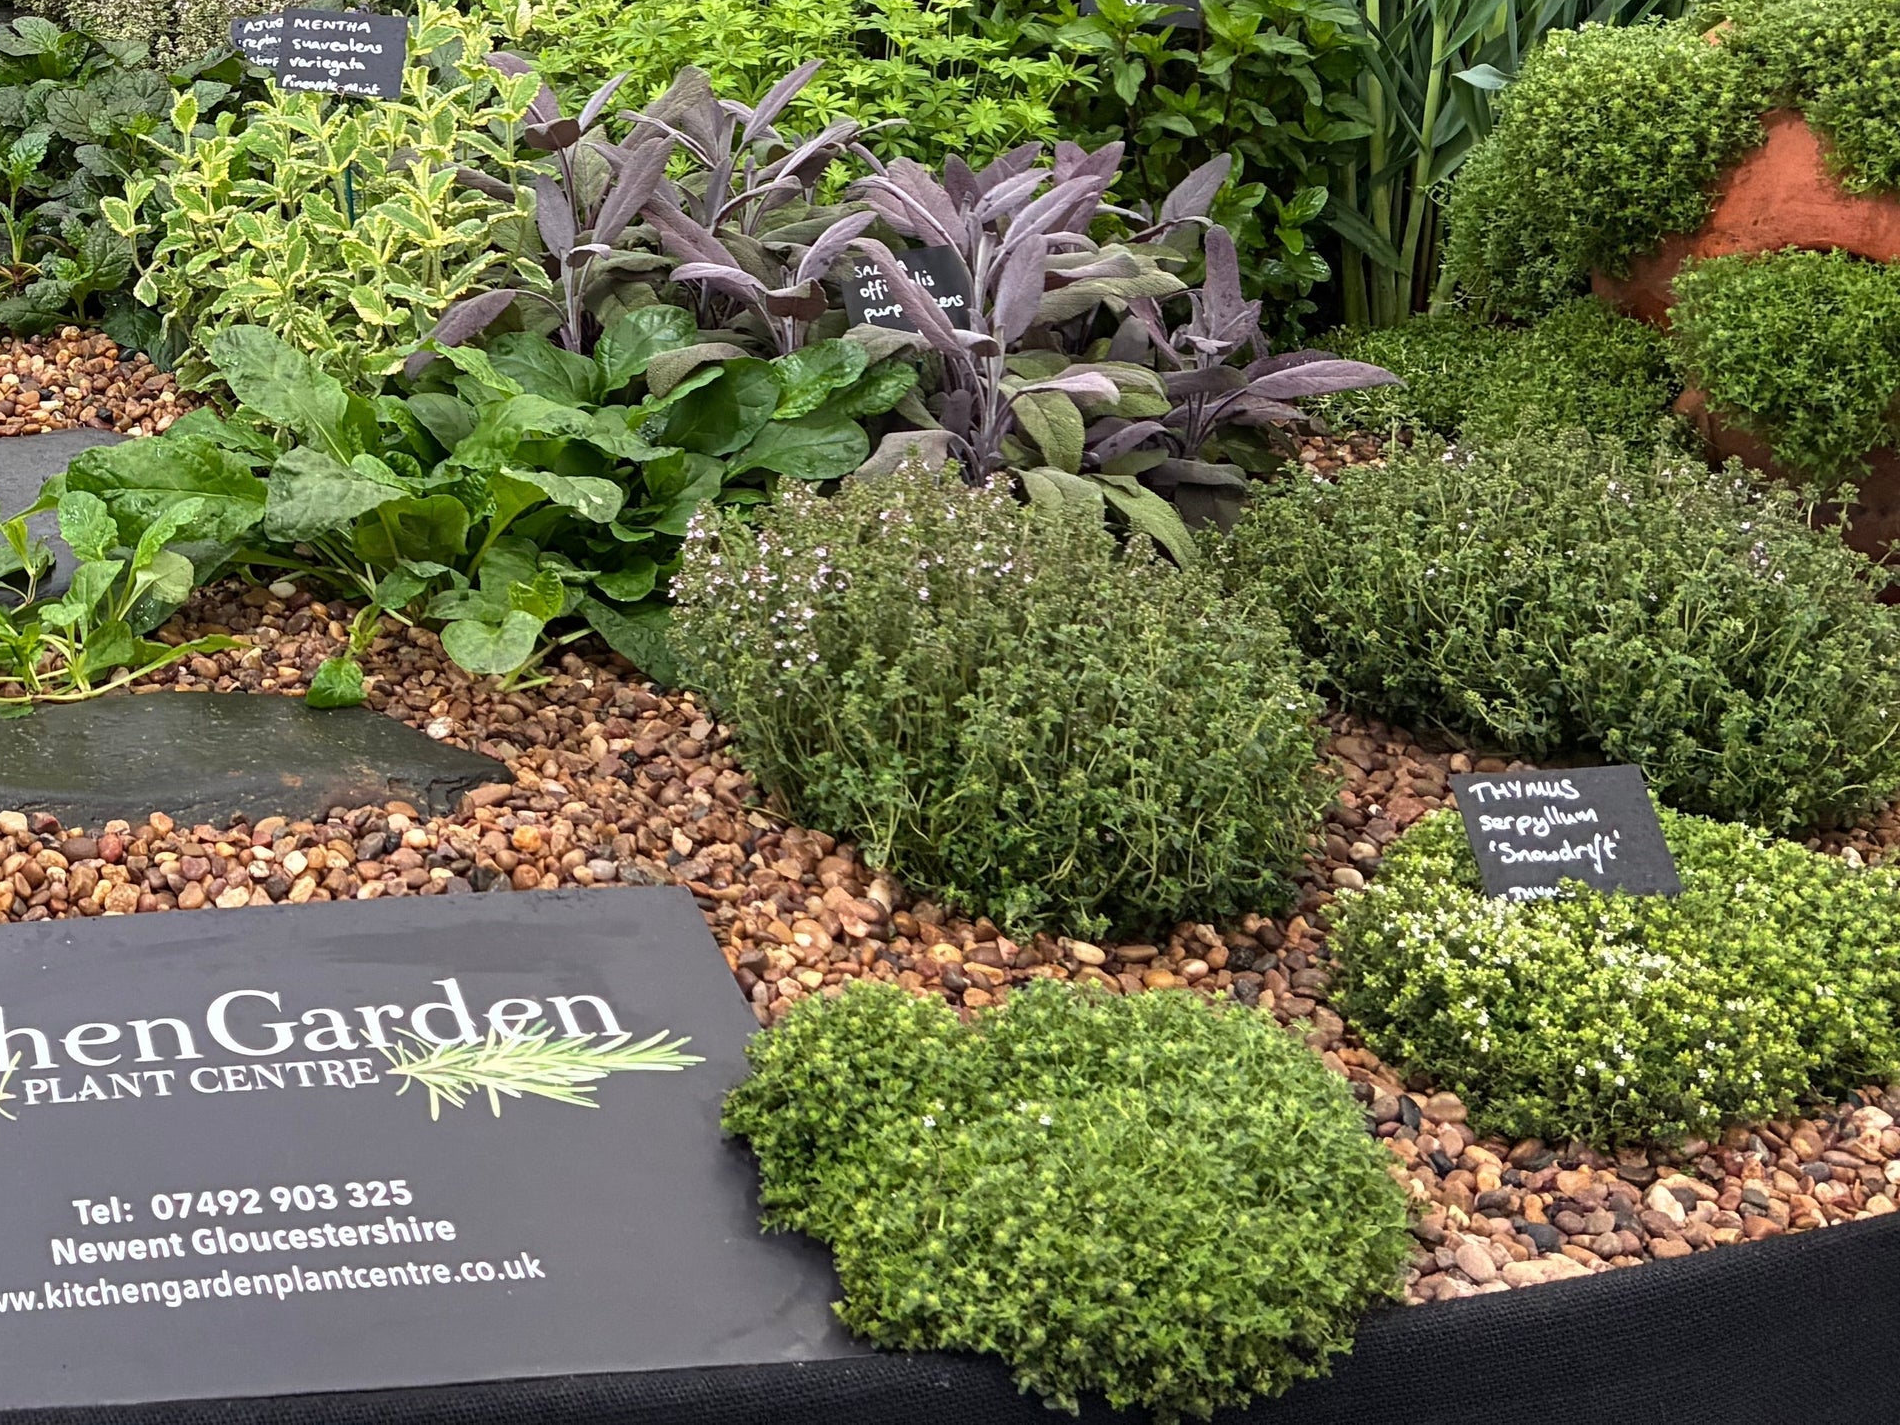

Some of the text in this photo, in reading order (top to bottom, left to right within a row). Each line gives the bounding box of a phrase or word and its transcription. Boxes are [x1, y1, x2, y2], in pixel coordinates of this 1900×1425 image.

[294, 18, 371, 34] MENTHA
[1468, 778, 1581, 803] THYMUS
[1478, 806, 1599, 837] serpyllum
[22, 1057, 380, 1106] PLANT CENTRE
[72, 1178, 414, 1226] Tel: 07492 903 325
[50, 1215, 458, 1266] Newent Gloucestershire
